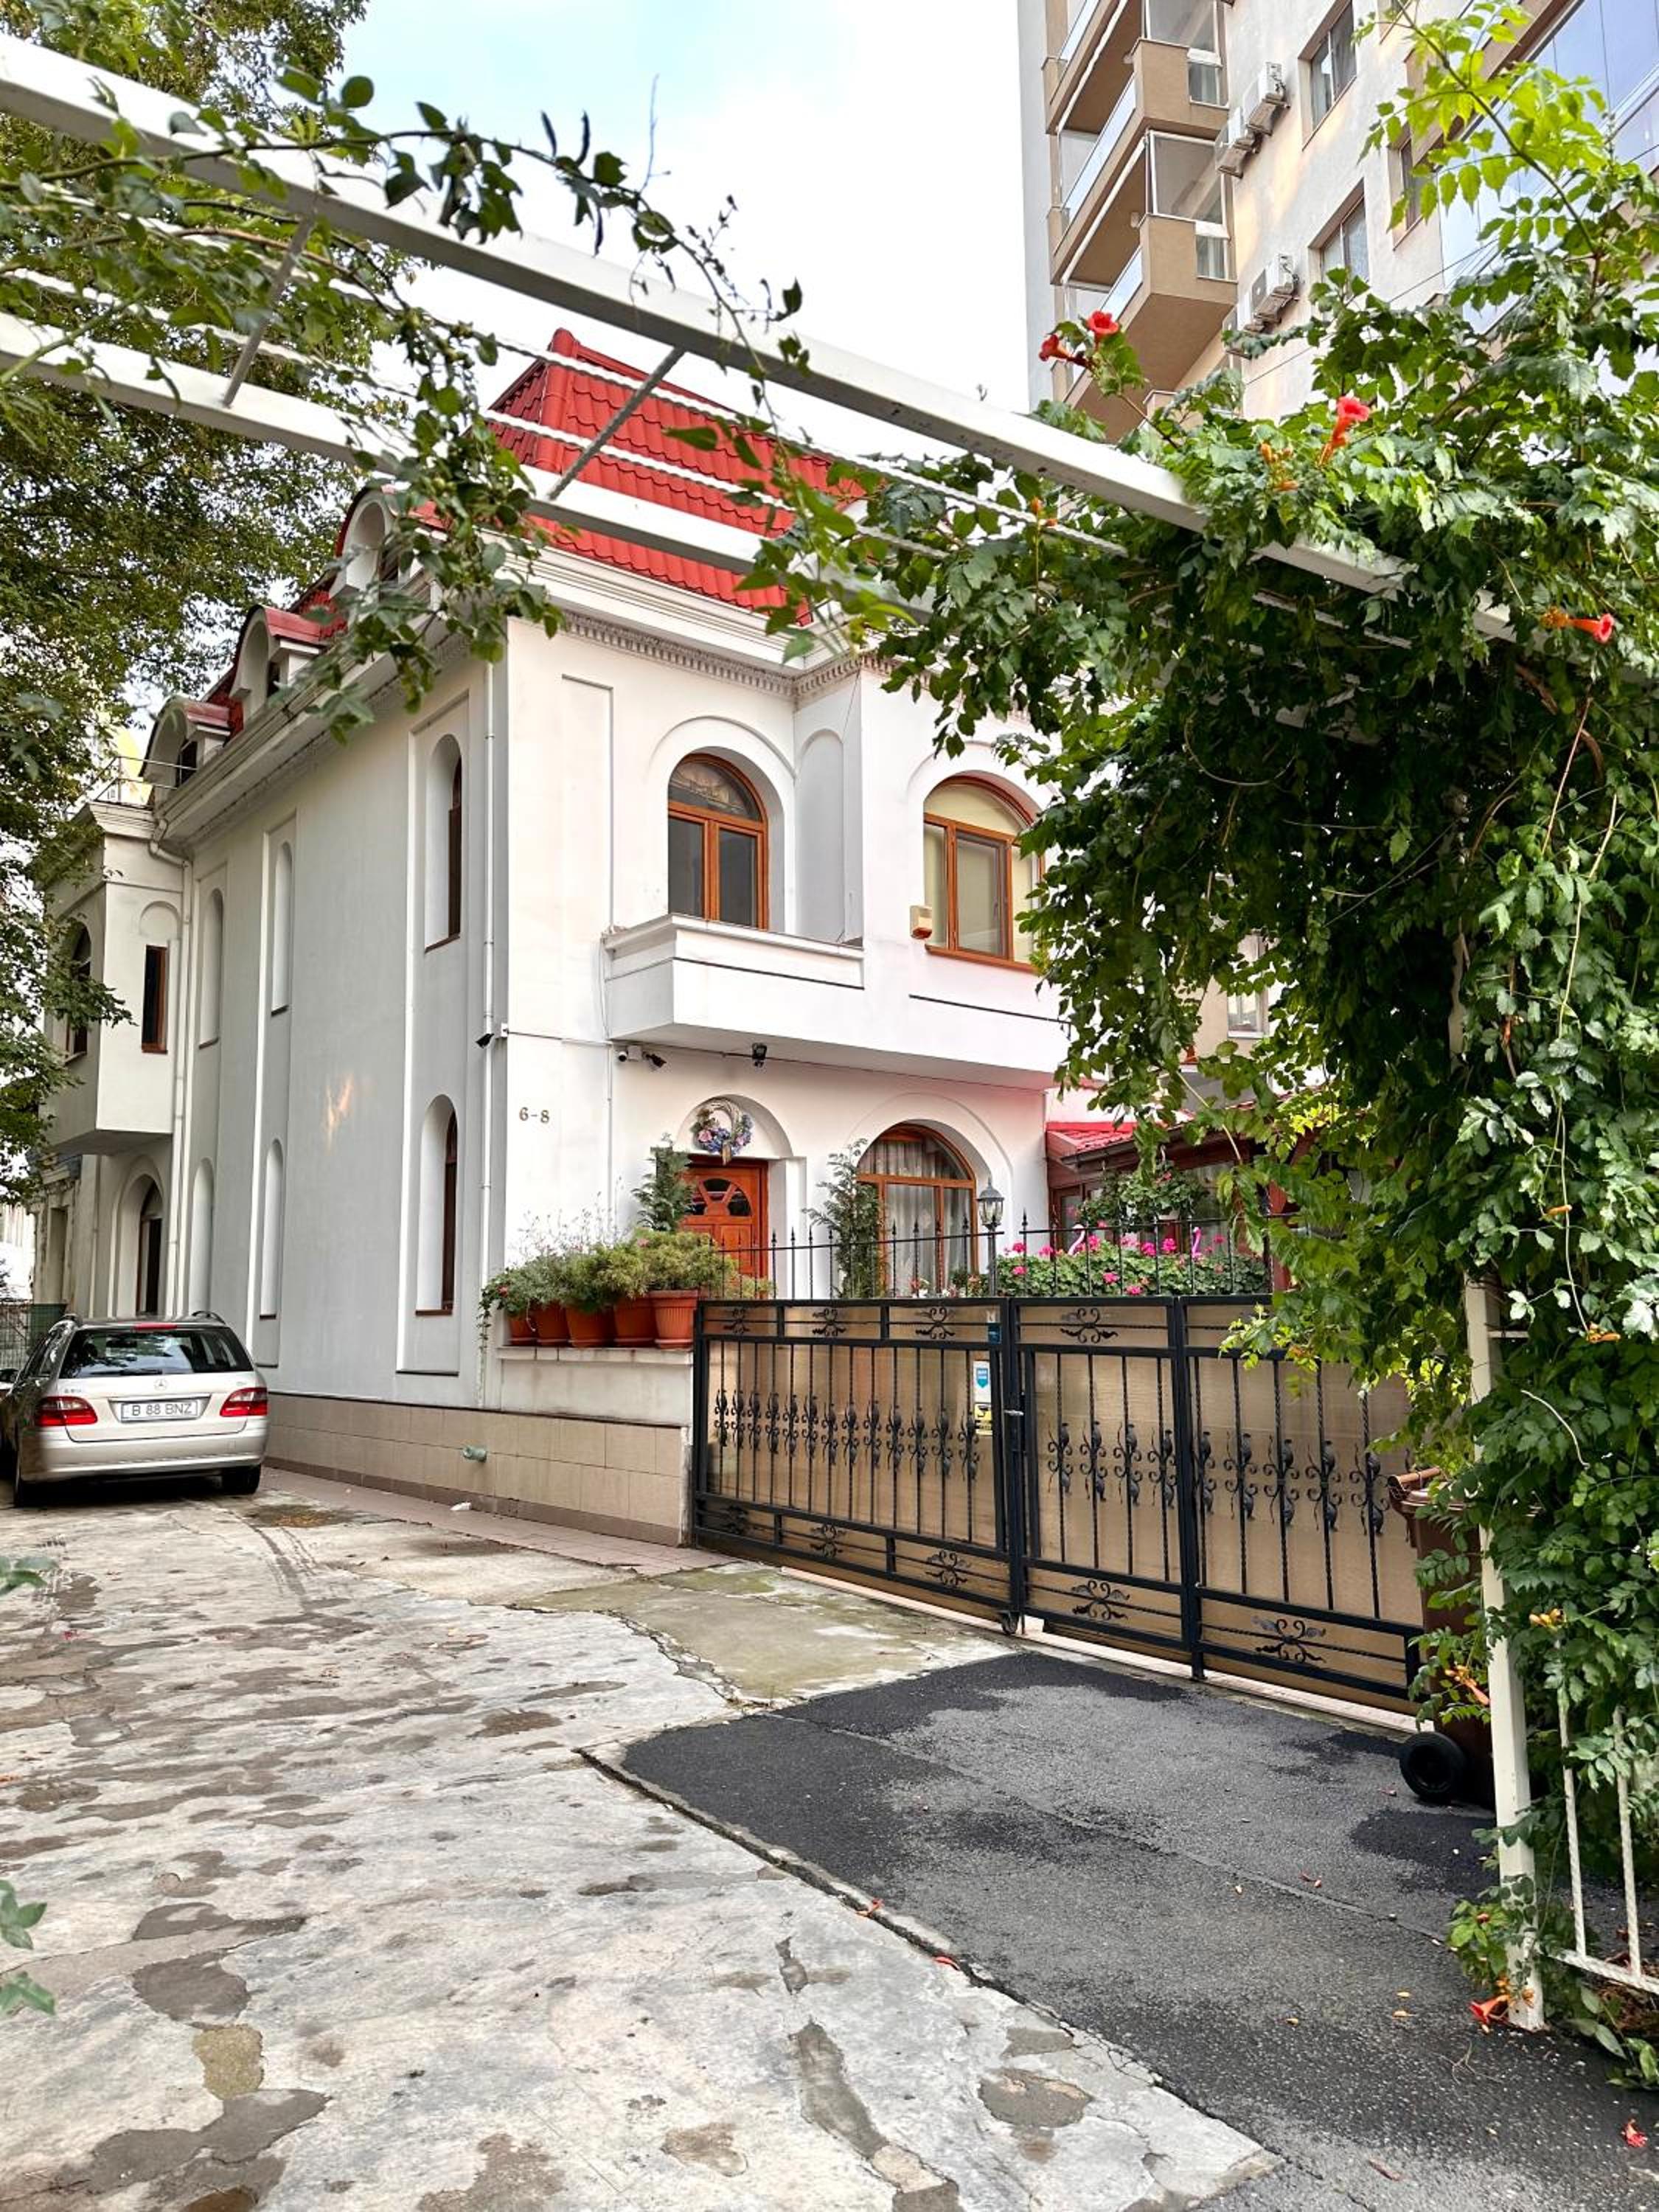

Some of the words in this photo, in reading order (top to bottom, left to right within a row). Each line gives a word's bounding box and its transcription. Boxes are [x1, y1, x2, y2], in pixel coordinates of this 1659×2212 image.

[519, 1107, 549, 1124] 6-8
[132, 1405, 141, 1416] B
[146, 1403, 161, 1415] 88
[164, 1403, 192, 1415] BNZ
